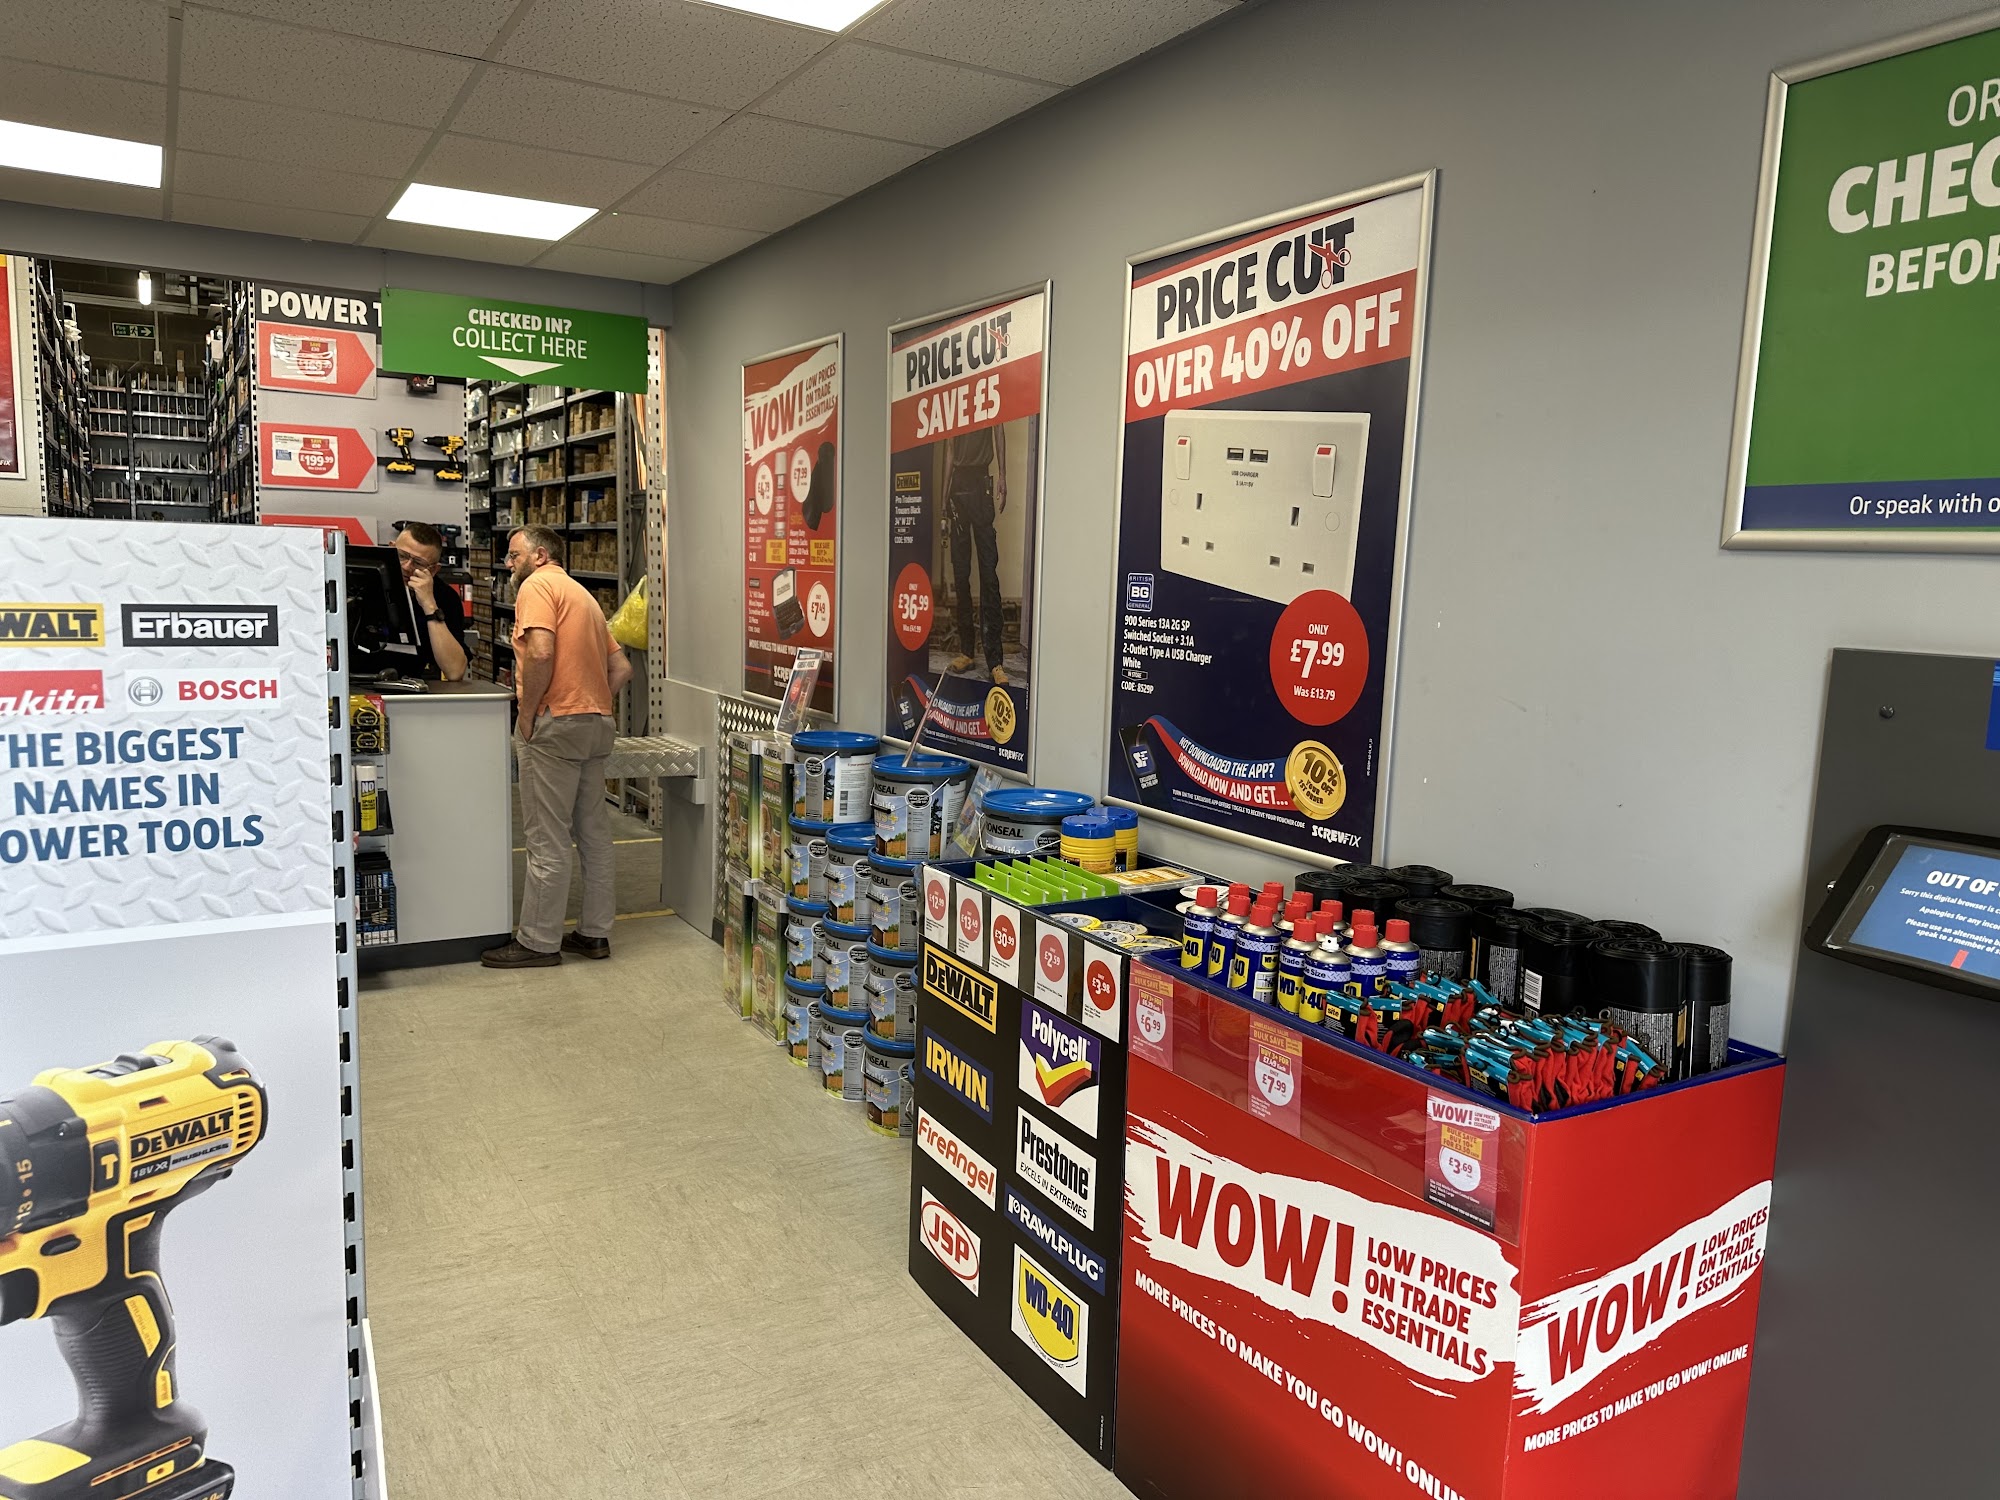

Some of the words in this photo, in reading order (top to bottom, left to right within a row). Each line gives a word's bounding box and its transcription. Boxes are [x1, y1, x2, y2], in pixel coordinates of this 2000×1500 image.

[1157, 252, 1257, 340] PRICE
[1267, 217, 1354, 302] CUT
[261, 289, 368, 326] POWER
[468, 308, 543, 332] CHECKED
[541, 317, 572, 335] IN?
[452, 326, 535, 355] COLLECT
[541, 335, 587, 359] HERE
[907, 332, 962, 392] PRICE
[967, 311, 1011, 369] CUT
[1135, 345, 1213, 408] OVER
[1221, 316, 1311, 383] 40%
[1322, 288, 1402, 359] OFF
[815, 382, 831, 401] TRADE
[751, 380, 803, 450] WOW!
[819, 362, 836, 383] PRICES
[806, 395, 834, 422] ESSENTIALS
[917, 385, 969, 439] SAVE
[974, 374, 1000, 423] £5
[300, 455, 334, 466] £199.99
[1849, 496, 1872, 515] Or
[1875, 494, 1932, 519] speak
[1938, 493, 1982, 514] with
[1131, 587, 1149, 598] BG
[898, 593, 929, 620] £36.99
[132, 612, 269, 639] Erbauer
[1125, 615, 1137, 626] 900
[1138, 616, 1157, 628] Series
[1158, 618, 1170, 629] 13A
[1171, 619, 1180, 630] 2G
[1181, 620, 1190, 631] SP
[1309, 624, 1329, 635] ONLY
[1124, 629, 1151, 642] Switched
[1152, 632, 1174, 644] Socket
[1180, 635, 1194, 647] 3.1A
[1123, 643, 1148, 656] 2-Outlet
[1149, 646, 1164, 659] Type
[1165, 648, 1170, 658] A
[1172, 649, 1184, 660] USB
[1185, 651, 1212, 665] Charger
[1123, 656, 1141, 668] White
[1290, 639, 1344, 678] £7.99
[179, 680, 277, 700] BOSCH
[1121, 681, 1136, 691] CODE:
[1294, 685, 1309, 697] Was
[1310, 688, 1335, 701] £13.79
[956, 722, 967, 735] AND
[76, 727, 244, 766] BIGGEST
[1179, 737, 1190, 751] NOT
[1188, 744, 1230, 773] DOWNLOADED
[1231, 763, 1247, 777] THE
[1248, 763, 1275, 778] APP?
[1178, 752, 1208, 785] DOWNLOAD
[1208, 775, 1229, 795] NOW
[1230, 783, 1251, 802] AND
[1254, 785, 1289, 806] GET...
[1302, 752, 1338, 787] 10%
[14, 775, 167, 815] NAMES
[178, 773, 220, 806] IN
[1306, 780, 1320, 795] YOUR
[1321, 782, 1335, 796] OFF
[139, 814, 264, 853] TOOLS
[1312, 825, 1361, 847] SCREWFIX
[1927, 871, 1970, 889] OUT
[1969, 879, 1999, 895] OF
[1900, 888, 1919, 897] Sorry
[1934, 894, 1957, 904] digital
[1957, 899, 1987, 911] browser
[1919, 906, 1954, 919] Apologies
[995, 930, 1014, 947] £30.99
[1906, 918, 1929, 928] Please
[1953, 929, 1994, 945] alternative
[1916, 929, 1938, 938] speak
[1953, 938, 1985, 950] member
[1032, 1010, 1087, 1062] Polycell
[1141, 1015, 1160, 1032] £6.99
[1254, 1029, 1268, 1043] BULK
[1269, 1035, 1285, 1048] SAVE
[1261, 1047, 1271, 1057] BUY
[1279, 1055, 1289, 1066] FOR
[926, 1036, 987, 1110] IRWIN
[1262, 1073, 1286, 1094] £7.99
[1432, 1102, 1472, 1125] WOW!
[1461, 1131, 1477, 1143] SAVE
[16, 1158, 33, 1180] 15
[918, 1117, 995, 1194] FireAngel
[1021, 1115, 1089, 1200] Prestone
[1449, 1157, 1472, 1174] £3.69
[133, 1164, 153, 1179] 18V
[1020, 1163, 1042, 1184] EXCELS
[1042, 1178, 1048, 1190] IN
[1049, 1183, 1087, 1219] EXTREMES
[929, 1212, 969, 1265] JSP
[1020, 1203, 1099, 1281] RAWLPLUG
[1155, 1155, 1355, 1314] WOW!
[1367, 1236, 1415, 1276] LOW
[1420, 1257, 1497, 1309] PRICES
[1698, 1257, 1717, 1277] ON
[1718, 1233, 1756, 1266] TRADE
[1695, 1248, 1761, 1300] ESSENTIALS
[1025, 1268, 1074, 1341] WD-40
[1365, 1269, 1397, 1300] ON
[1400, 1282, 1471, 1334] TRADE
[1547, 1242, 1697, 1386] WOW!
[1702, 1228, 1730, 1255] LOW
[1731, 1206, 1768, 1238] PRICES
[1362, 1298, 1487, 1376] ESSENTIALS
[1135, 1269, 1170, 1309] MORE
[1172, 1294, 1217, 1341] PRICES
[1219, 1324, 1237, 1353] TO
[1238, 1342, 1282, 1387] MAKE
[1285, 1370, 1318, 1410] YOU
[1320, 1397, 1344, 1428] GO
[1347, 1415, 1403, 1473] WOW!
[1523, 1427, 1561, 1452] MORE
[1562, 1410, 1599, 1440] PRICES
[1600, 1406, 1613, 1424] TO
[1614, 1392, 1643, 1417] MAKE
[1644, 1382, 1665, 1405] YOU
[1666, 1374, 1680, 1392] GO
[1681, 1362, 1712, 1384] WOW!
[1712, 1344, 1749, 1370] ONLINE
